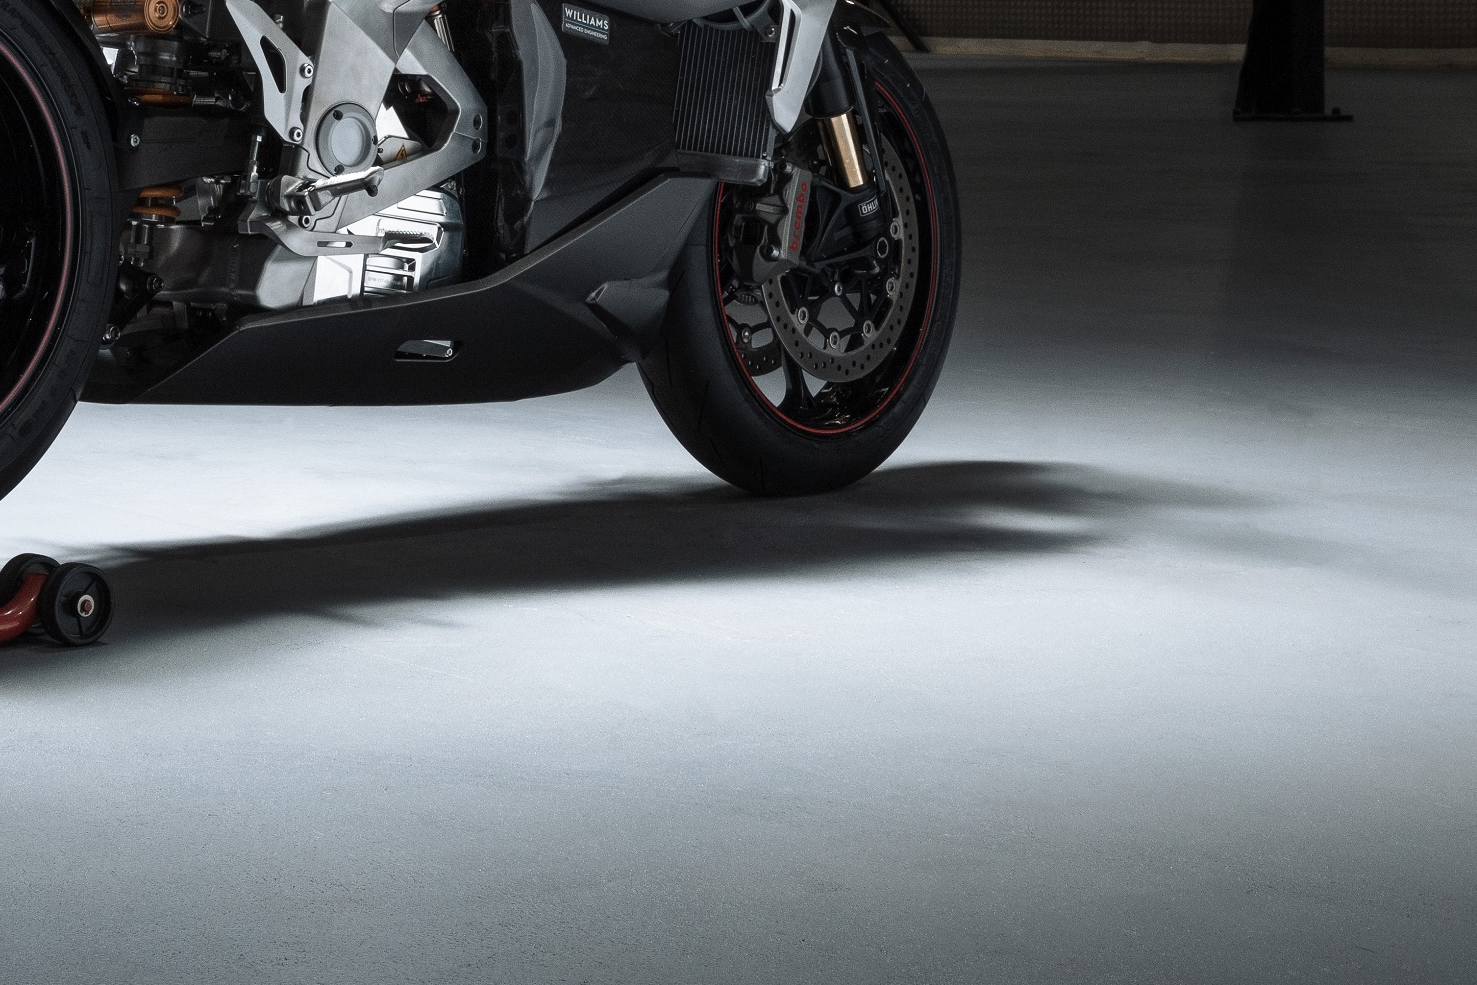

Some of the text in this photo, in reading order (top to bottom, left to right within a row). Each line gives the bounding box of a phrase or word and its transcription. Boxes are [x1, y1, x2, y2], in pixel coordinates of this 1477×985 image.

[565, 7, 609, 30] WILLIAMS
[565, 23, 583, 33] ADVANCED
[789, 182, 808, 251] brembo
